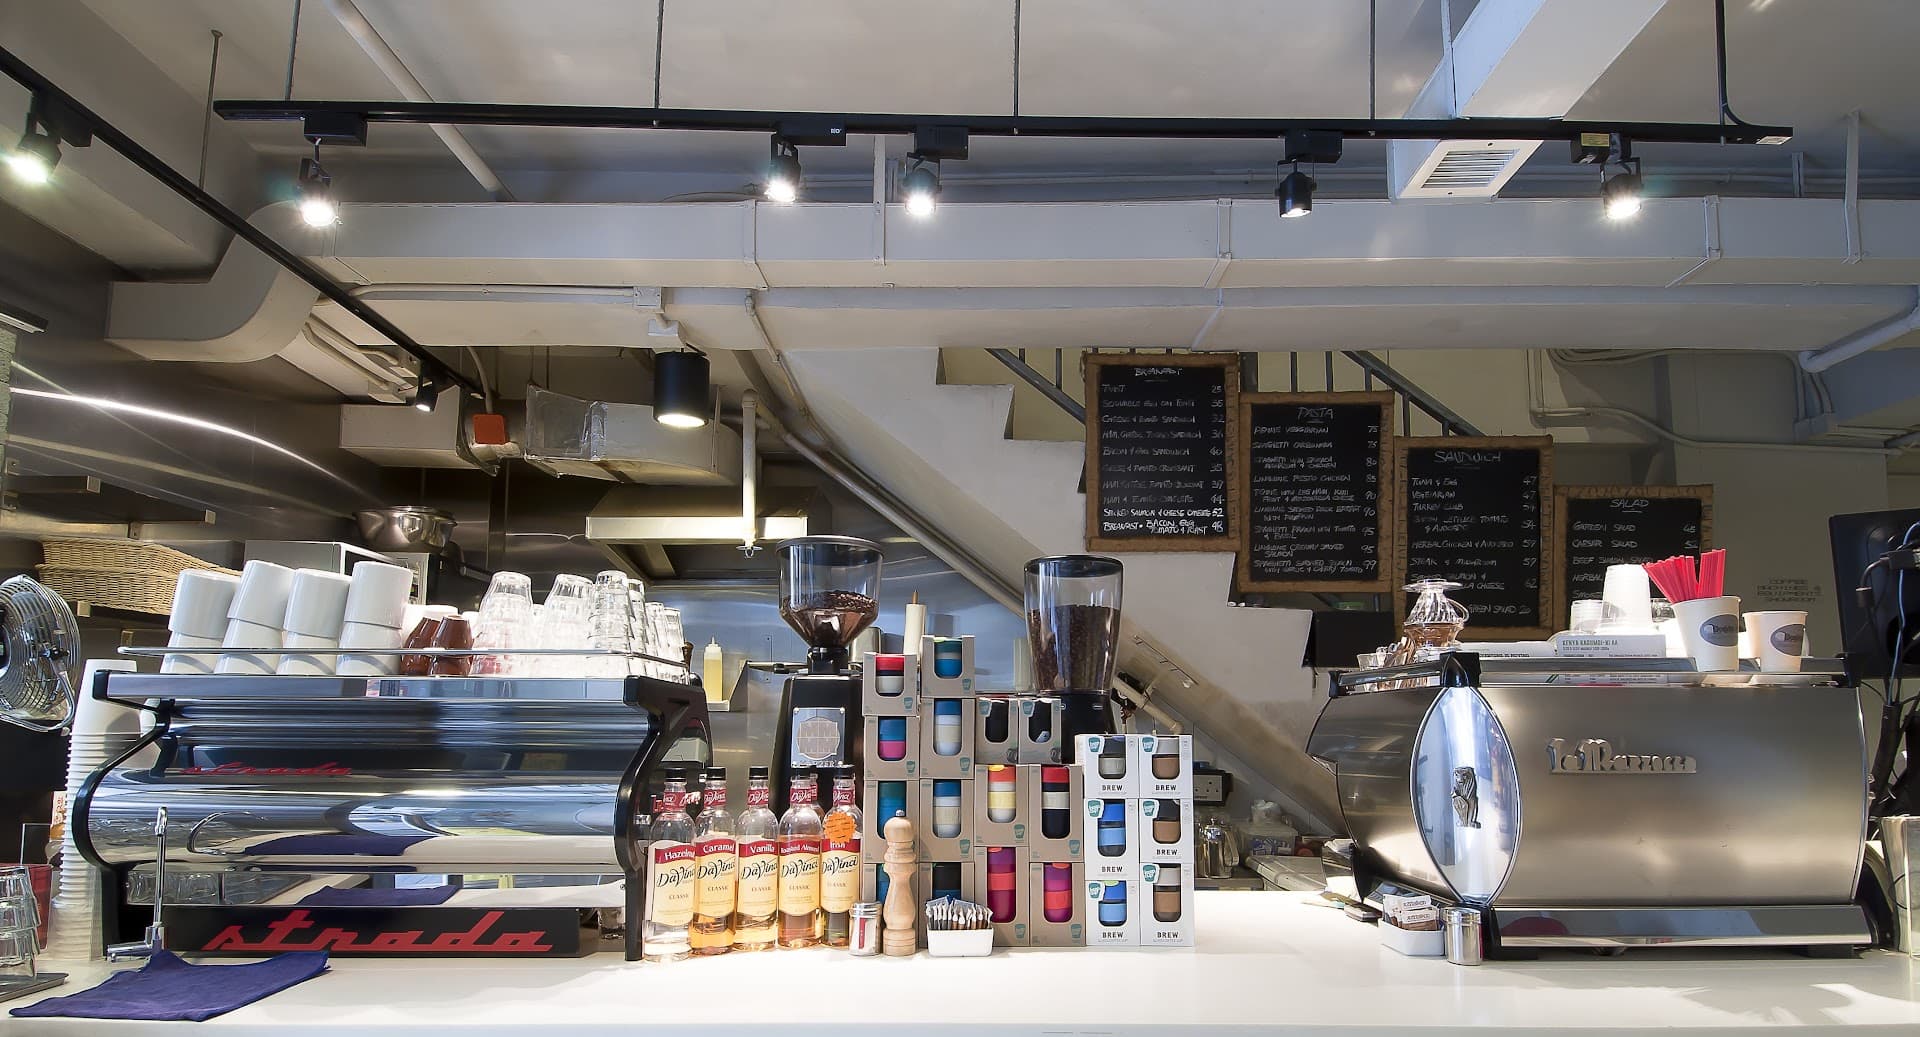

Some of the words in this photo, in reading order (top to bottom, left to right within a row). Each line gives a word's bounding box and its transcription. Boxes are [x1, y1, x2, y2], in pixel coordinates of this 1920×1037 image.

[1297, 407, 1334, 419] PASTA
[1434, 450, 1501, 463] SANDWICH
[1411, 477, 1433, 486] TUNA
[1609, 499, 1649, 509] SALAD
[1130, 508, 1155, 517] SALMON
[1264, 550, 1294, 558] SALMON
[1572, 573, 1604, 582] HERBAL
[703, 843, 735, 854] Caramel
[750, 843, 775, 854] Vanilla
[201, 910, 554, 952] strada
